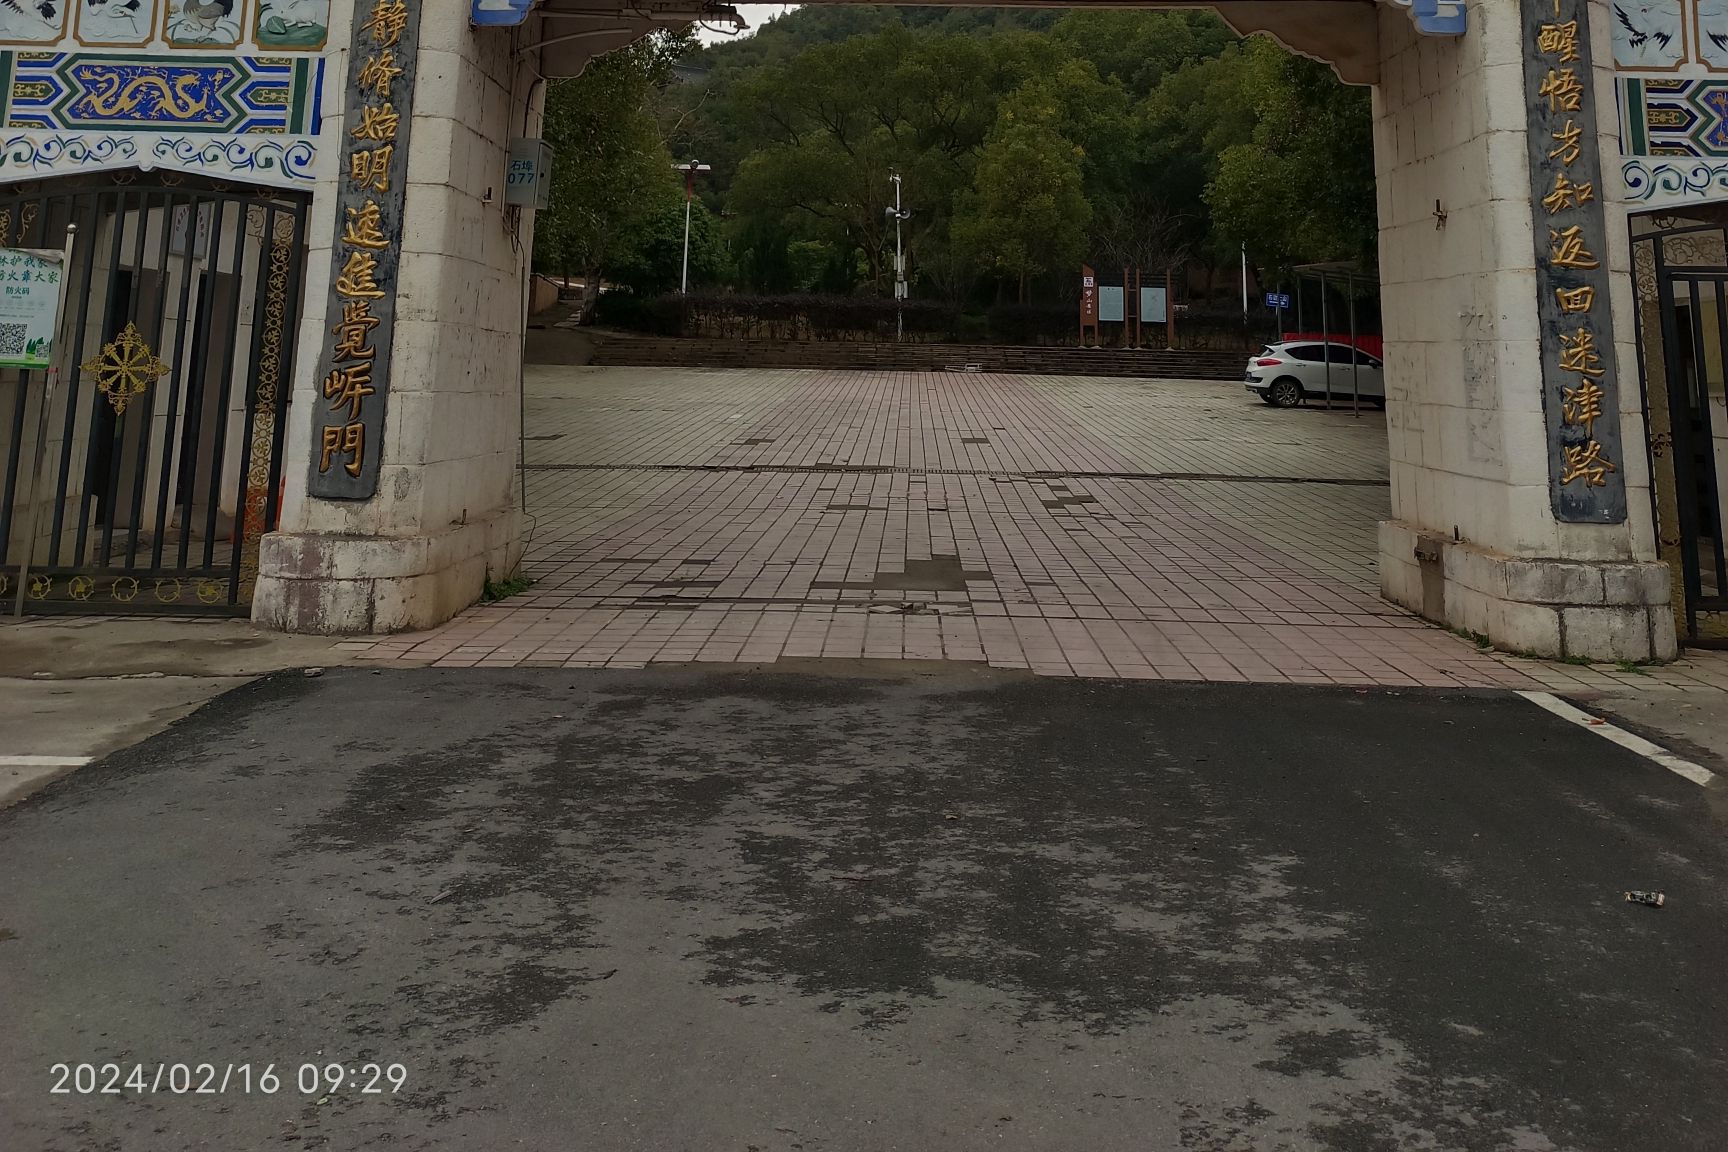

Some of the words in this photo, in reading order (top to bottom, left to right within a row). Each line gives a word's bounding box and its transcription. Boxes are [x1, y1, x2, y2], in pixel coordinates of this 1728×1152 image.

[508, 173, 534, 184] 077
[6, 286, 30, 295] 防火码
